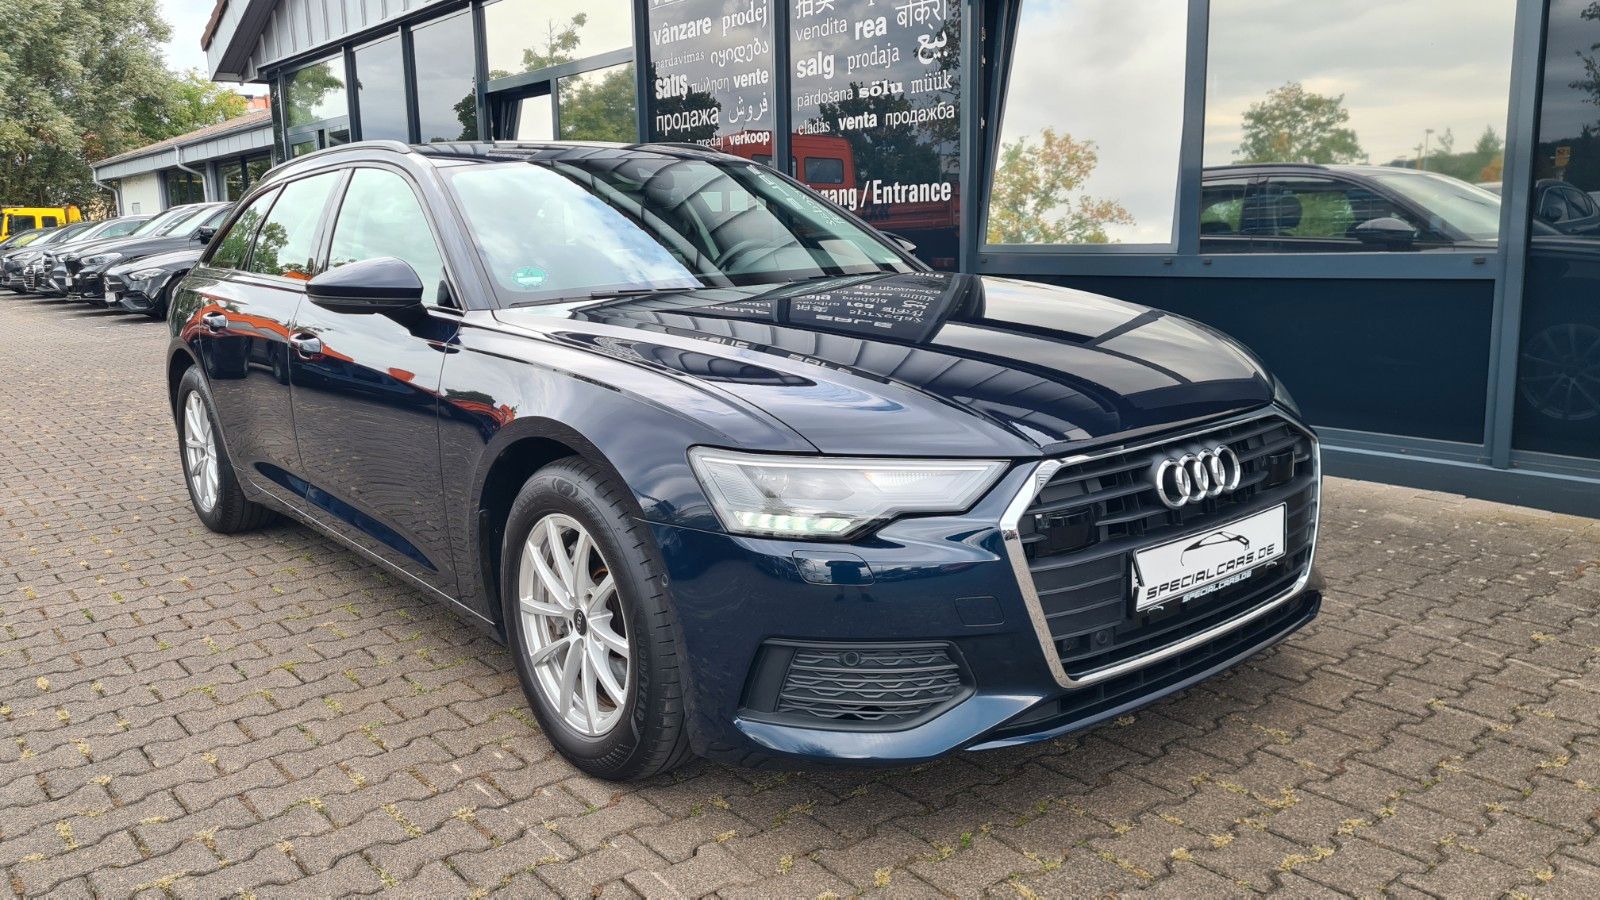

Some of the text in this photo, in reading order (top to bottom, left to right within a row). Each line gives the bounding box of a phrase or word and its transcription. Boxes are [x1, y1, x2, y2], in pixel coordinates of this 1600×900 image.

[653, 0, 768, 46] vânzare prodej
[795, 16, 887, 42] vendita rea
[917, 30, 948, 65] بيع
[655, 51, 705, 71] pardavimas
[796, 43, 900, 80] salg prodaja
[655, 74, 689, 100] satış
[733, 68, 769, 89] vente
[797, 70, 953, 112] pārdošana sölu müük
[656, 106, 719, 136] продажа
[797, 111, 878, 136] eladás venta
[885, 101, 955, 129] продажба
[729, 131, 770, 146] verkoop
[872, 179, 952, 205] Entrance
